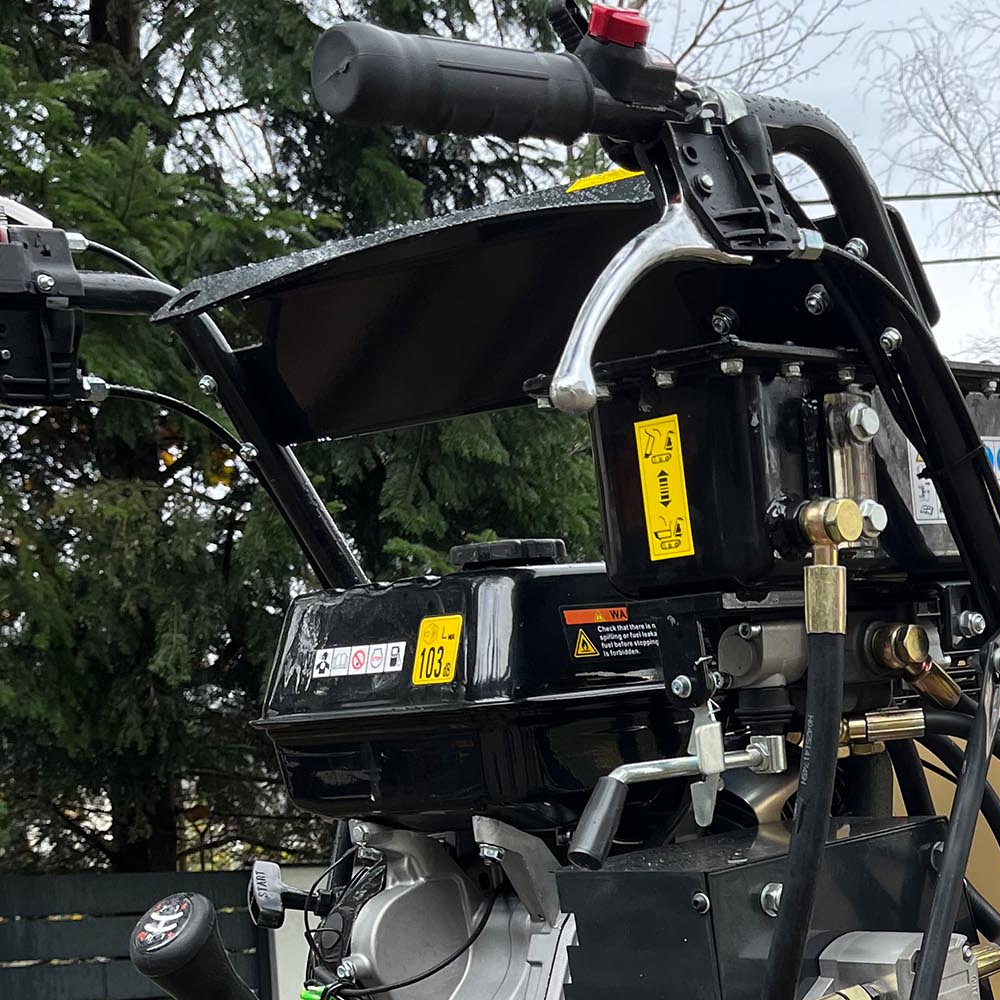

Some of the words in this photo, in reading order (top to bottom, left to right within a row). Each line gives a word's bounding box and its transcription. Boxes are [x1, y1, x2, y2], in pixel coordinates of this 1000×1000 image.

[609, 609, 627, 620] WA
[597, 625, 617, 633] Check
[629, 623, 645, 631] there
[600, 633, 623, 641] spilling
[601, 641, 614, 649] fuel
[419, 645, 444, 680] 103
[255, 871, 268, 898] START
